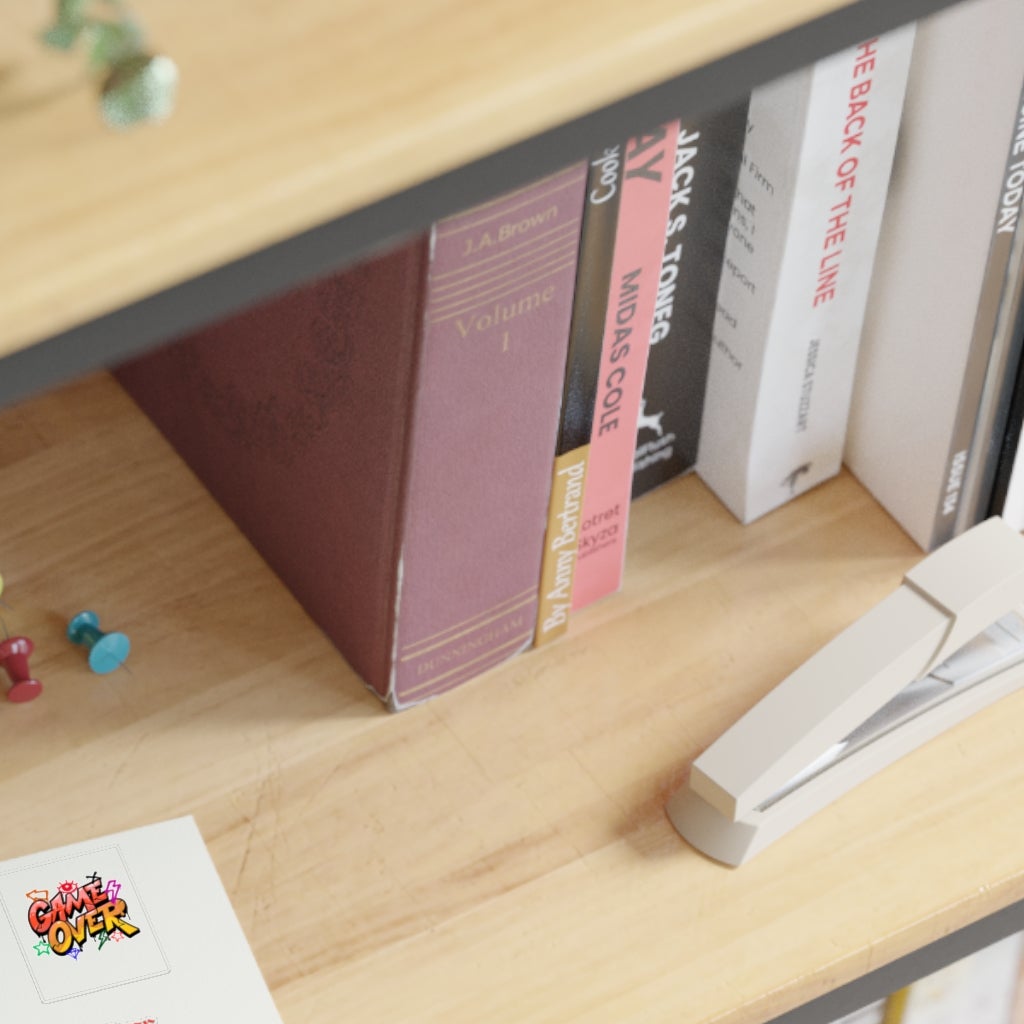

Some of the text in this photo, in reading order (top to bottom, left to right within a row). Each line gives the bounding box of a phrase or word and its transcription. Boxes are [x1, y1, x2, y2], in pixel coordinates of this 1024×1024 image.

[841, 78, 872, 154] BACK
[590, 145, 620, 204] Cook
[668, 128, 700, 213] JACK
[834, 156, 859, 191] OF
[824, 194, 853, 250] THE
[649, 243, 683, 346] TONEG
[812, 249, 843, 308] LINE
[455, 285, 556, 338] Volume
[598, 267, 643, 437] MIDAS COLE
[551, 460, 585, 551] Bertrand
[542, 603, 571, 633] By
[28, 877, 108, 934] GAME
[48, 898, 140, 955] OVER
